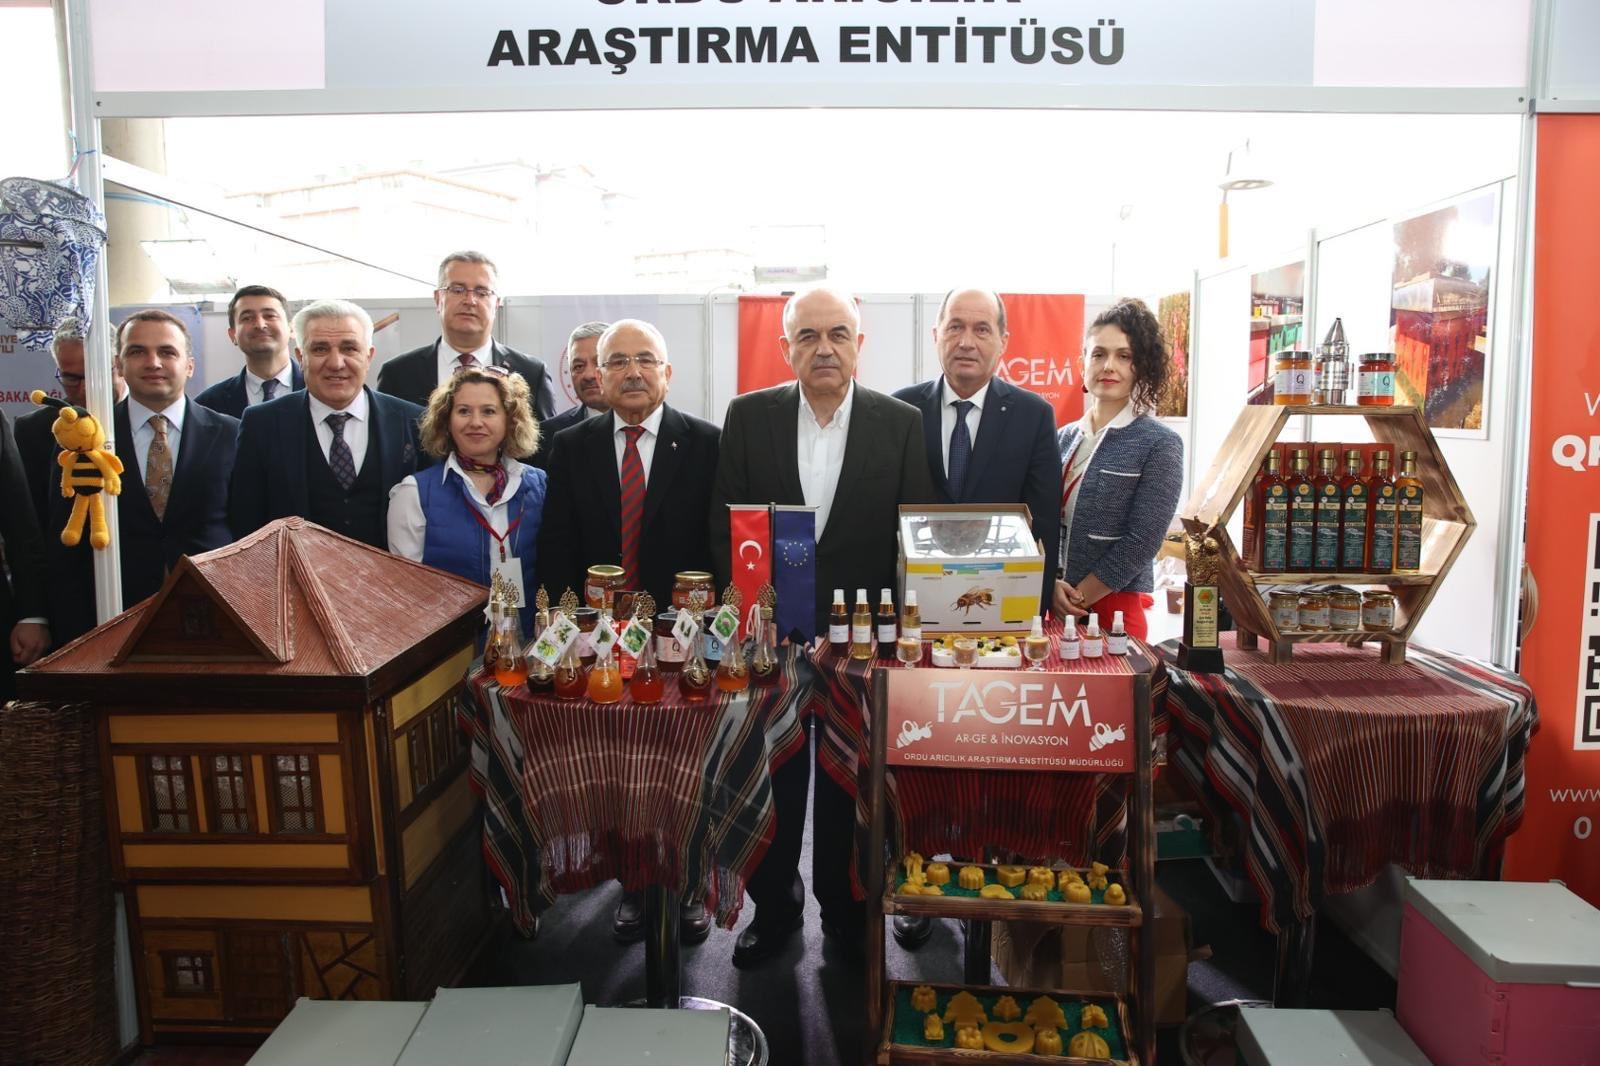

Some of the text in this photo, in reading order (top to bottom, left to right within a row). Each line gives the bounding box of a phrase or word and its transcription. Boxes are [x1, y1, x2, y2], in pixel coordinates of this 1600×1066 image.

[486, 17, 1125, 75] ARAŞTIRMA ENTİTÜSÜ
[994, 356, 1074, 387] AGEM
[928, 680, 1093, 727] TAGEM
[954, 732, 1069, 746] AR-GE & İNOVASYON
[903, 753, 1124, 767] ORDU ARICILIK ARAŞTIRMA ENSTİTÜSÜ MÜDÜRLÜĞÜ
